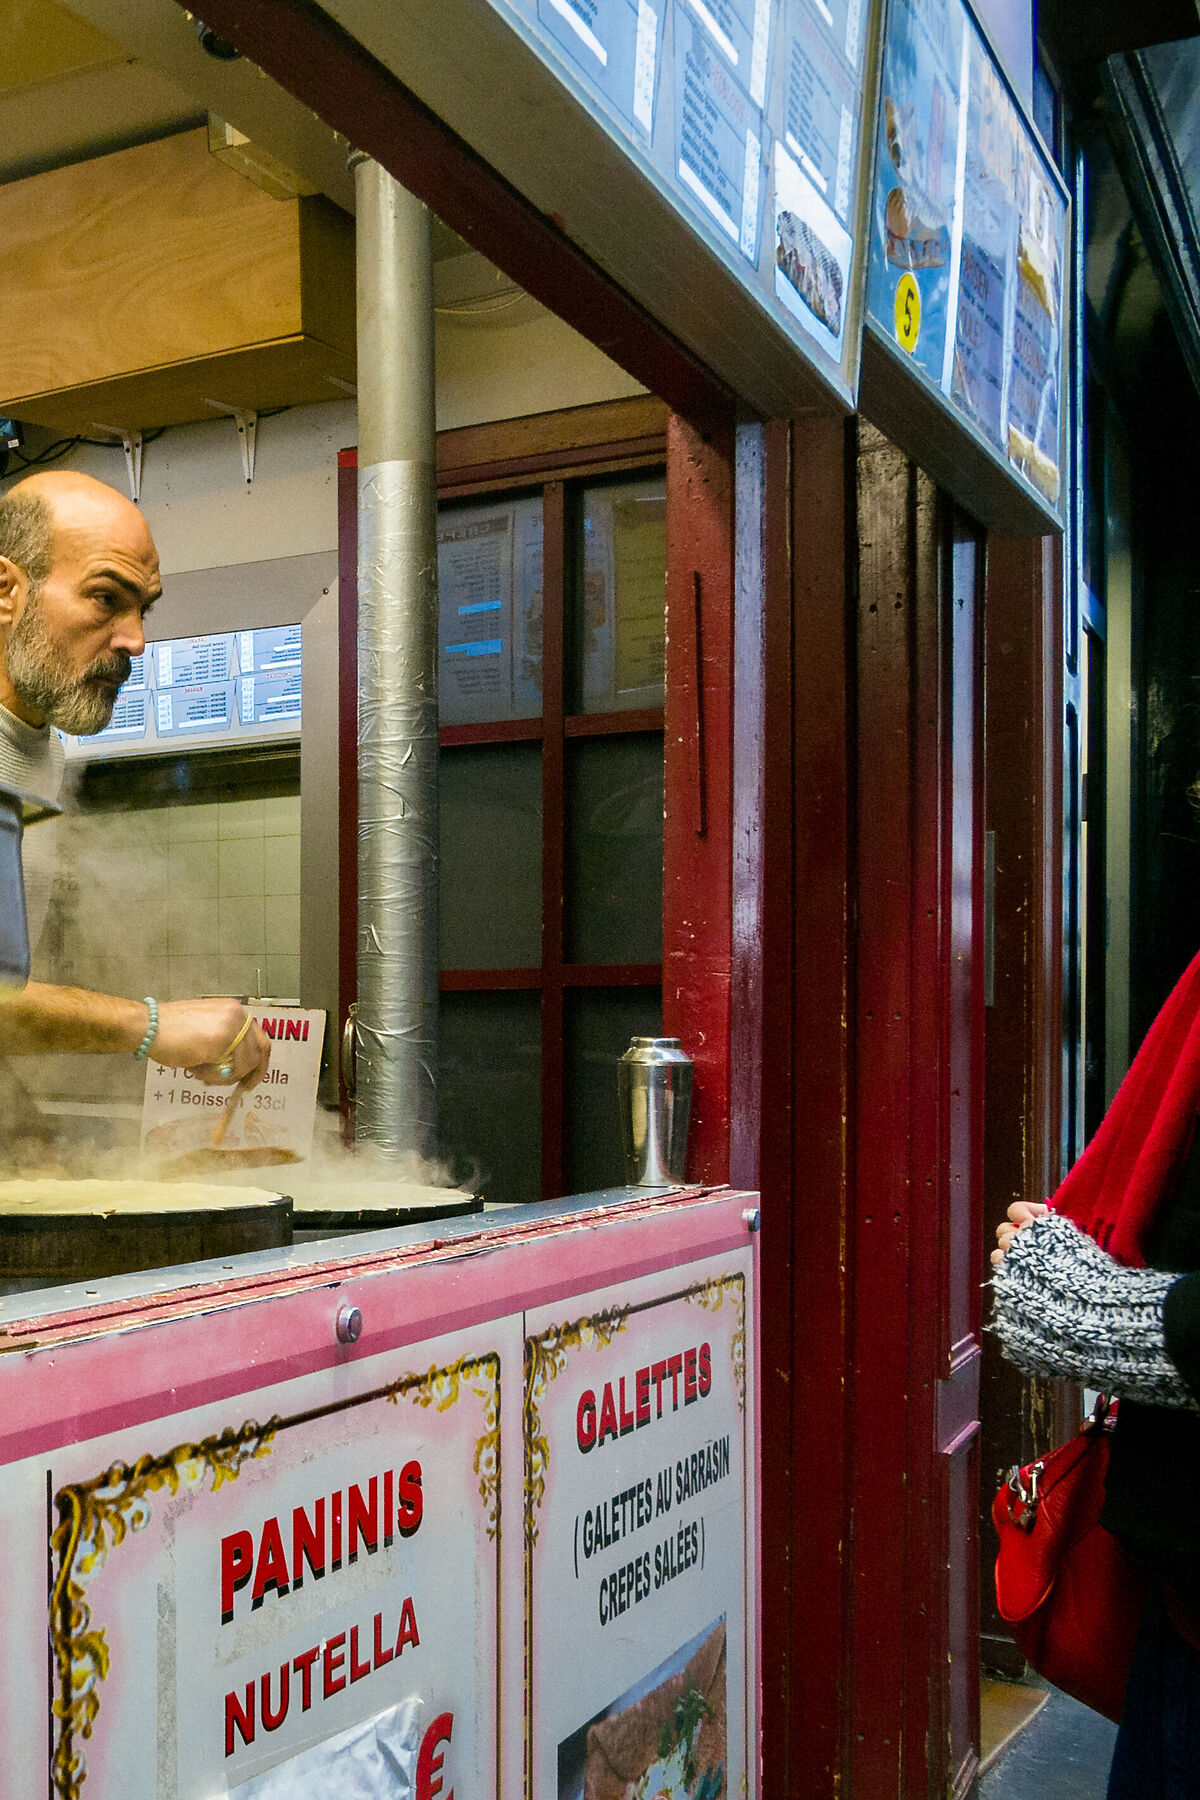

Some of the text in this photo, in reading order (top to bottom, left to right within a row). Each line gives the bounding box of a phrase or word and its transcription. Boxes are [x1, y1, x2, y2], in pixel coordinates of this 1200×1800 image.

[576, 1342, 712, 1454] GALETTES
[655, 1466, 672, 1518] AU
[675, 1434, 730, 1506] SARRASIN
[221, 1460, 423, 1626] PANINIS
[599, 1552, 651, 1626] CREPES
[225, 1596, 420, 1758] NUTELLA
